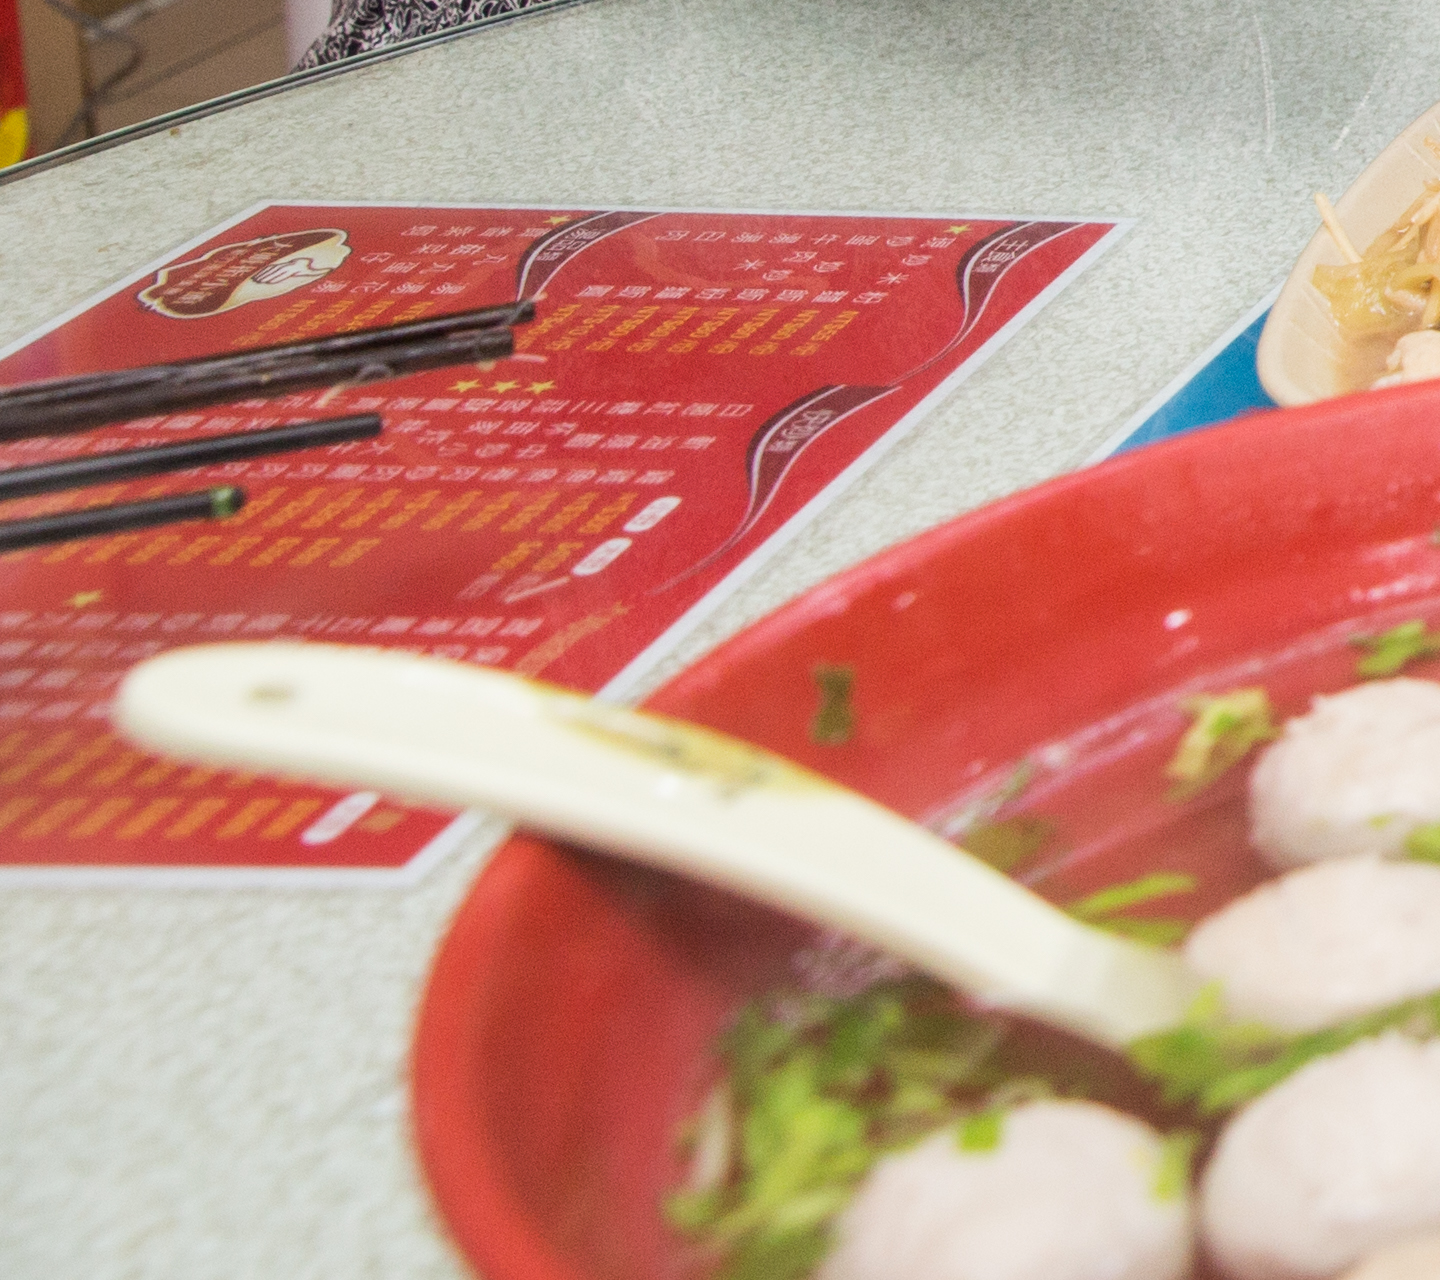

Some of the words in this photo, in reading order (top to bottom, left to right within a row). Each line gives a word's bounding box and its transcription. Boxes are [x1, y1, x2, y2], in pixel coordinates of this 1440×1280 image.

[386, 225, 517, 294] 香菇丸湯
[612, 230, 730, 298] 白飯
[650, 231, 769, 299] 湯麵
[689, 232, 807, 300] 湯米粉
[729, 233, 843, 301] 牛肉炒飯
[770, 234, 883, 302] 蛋炒飯
[807, 235, 919, 304] 炒麵
[847, 236, 959, 304] 現炒米粉
[976, 239, 1030, 276] 主食類
[769, 408, 833, 455] 快炒類
